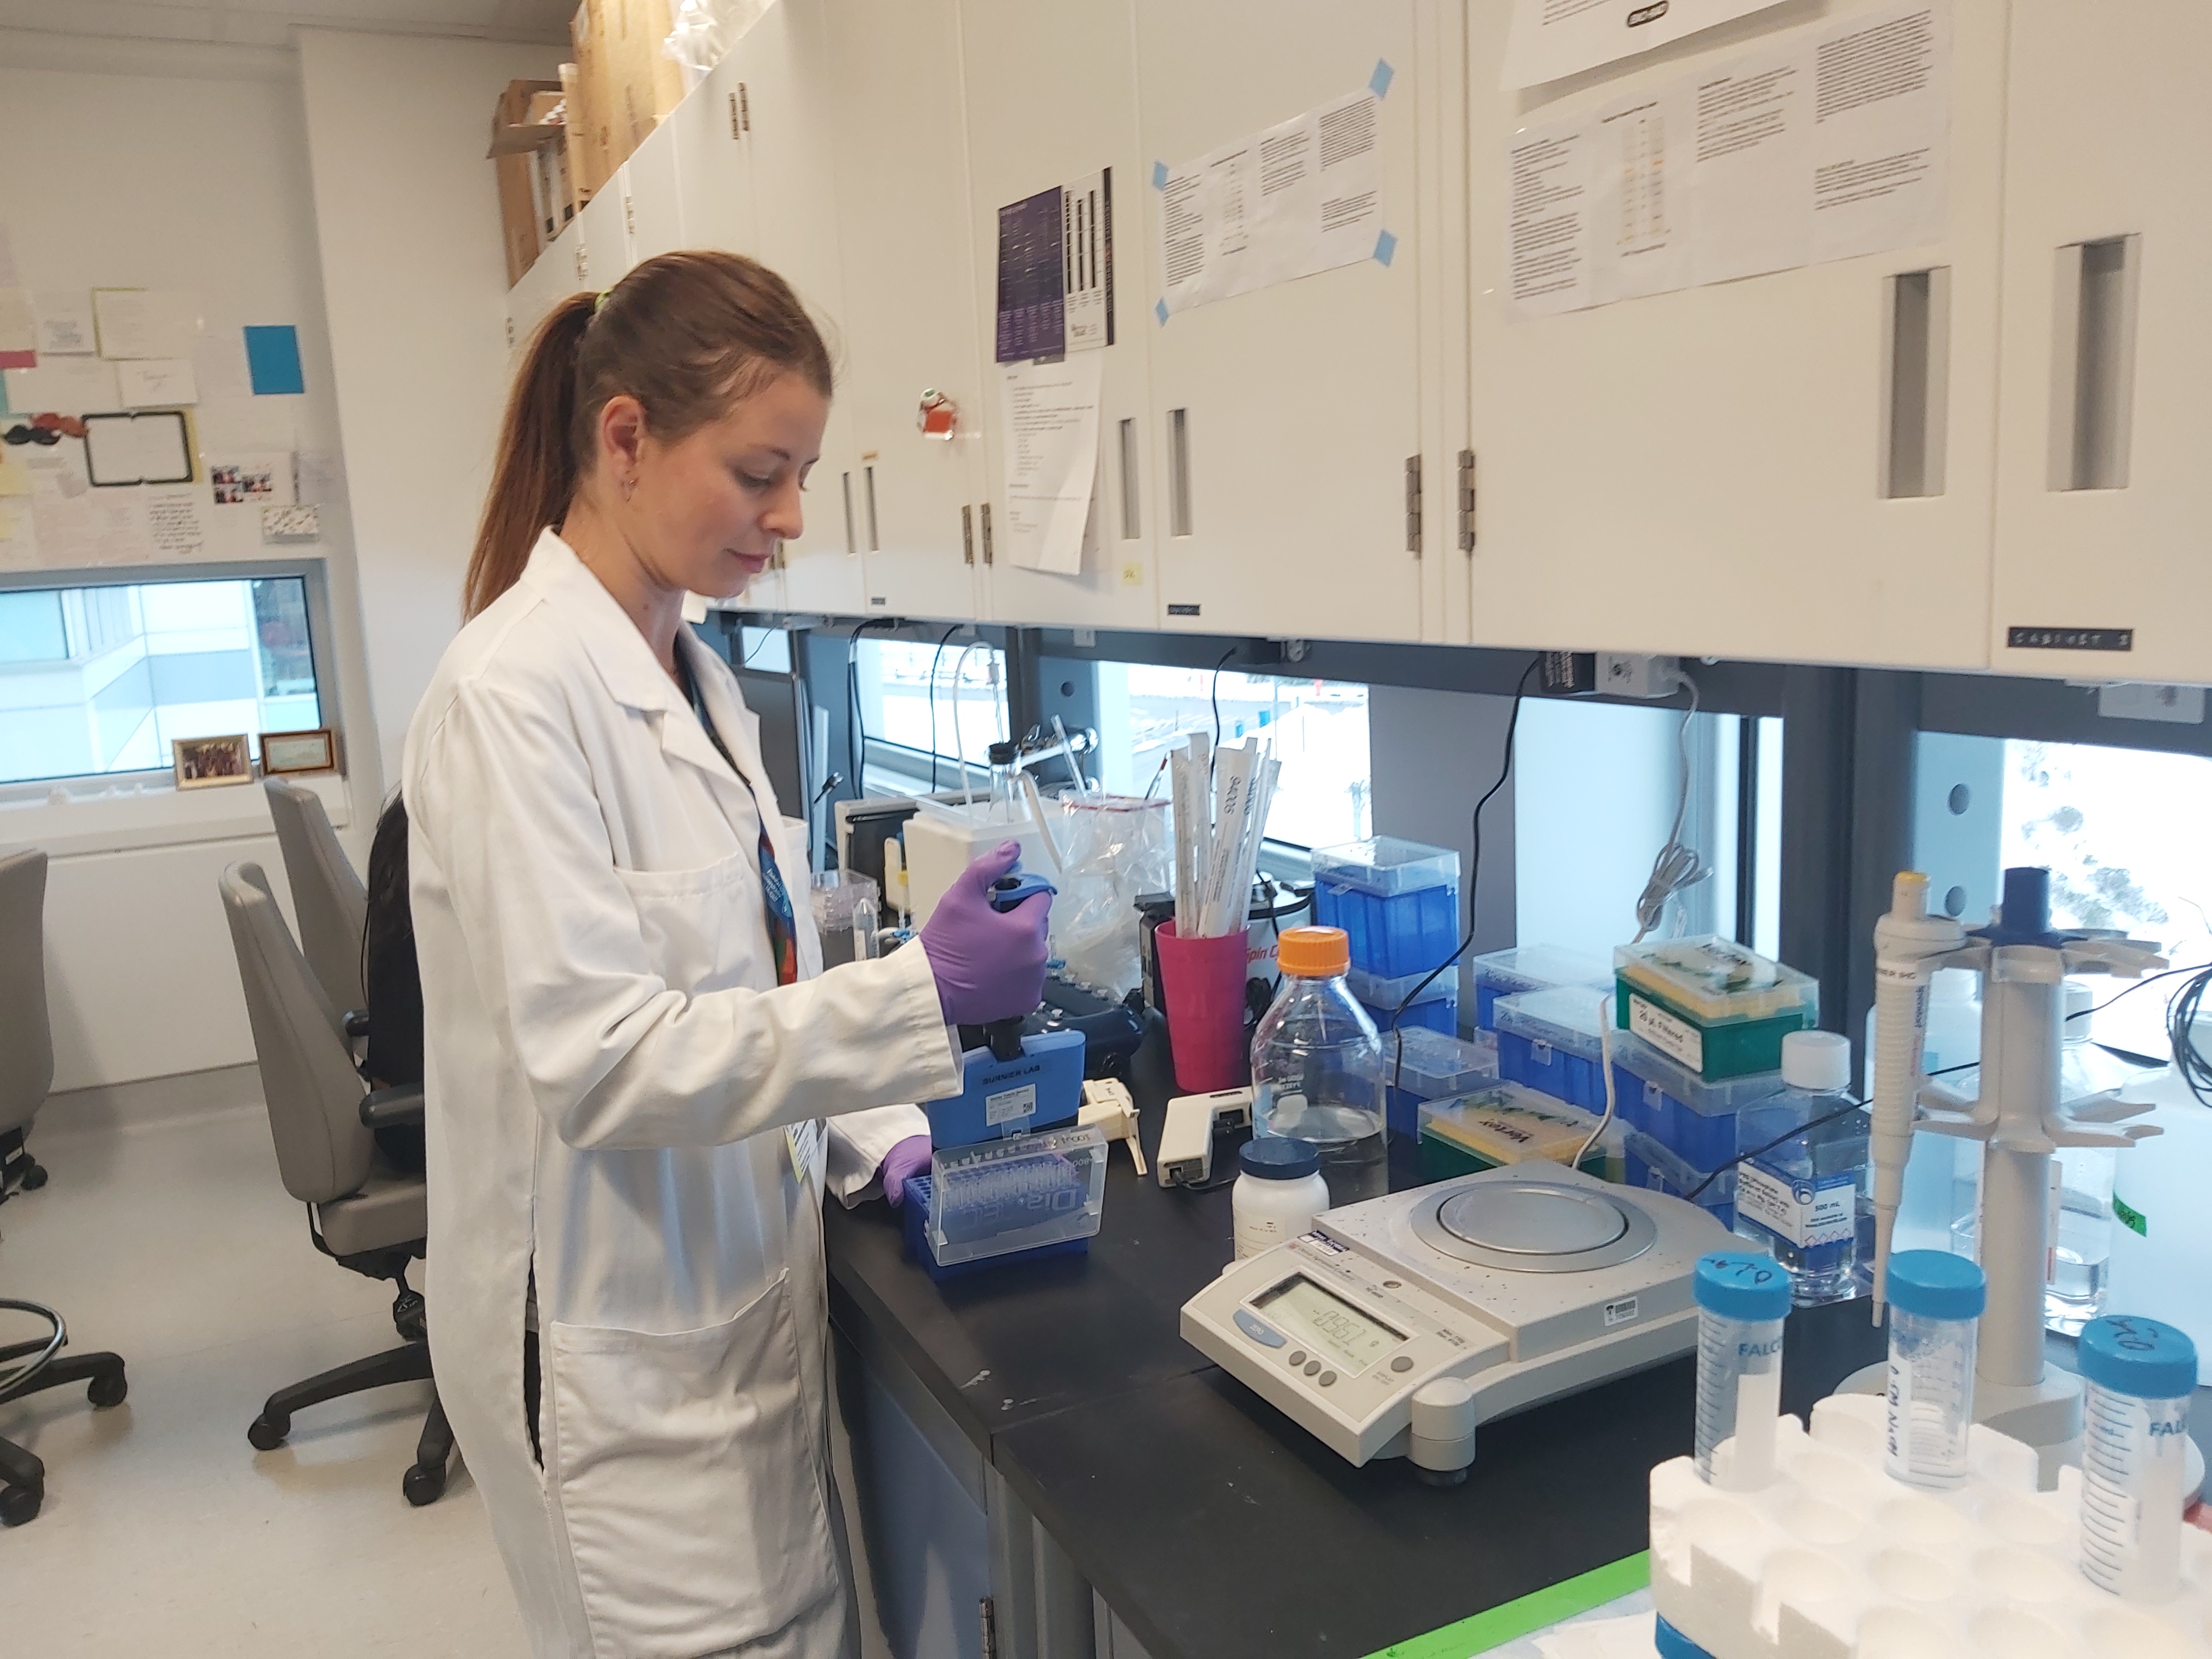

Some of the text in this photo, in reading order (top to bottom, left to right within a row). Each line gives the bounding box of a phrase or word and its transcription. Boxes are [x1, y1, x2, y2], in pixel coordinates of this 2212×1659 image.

[981, 1065, 1040, 1085] BURNIER LAB
[1249, 1324, 1265, 1335] ZERO
